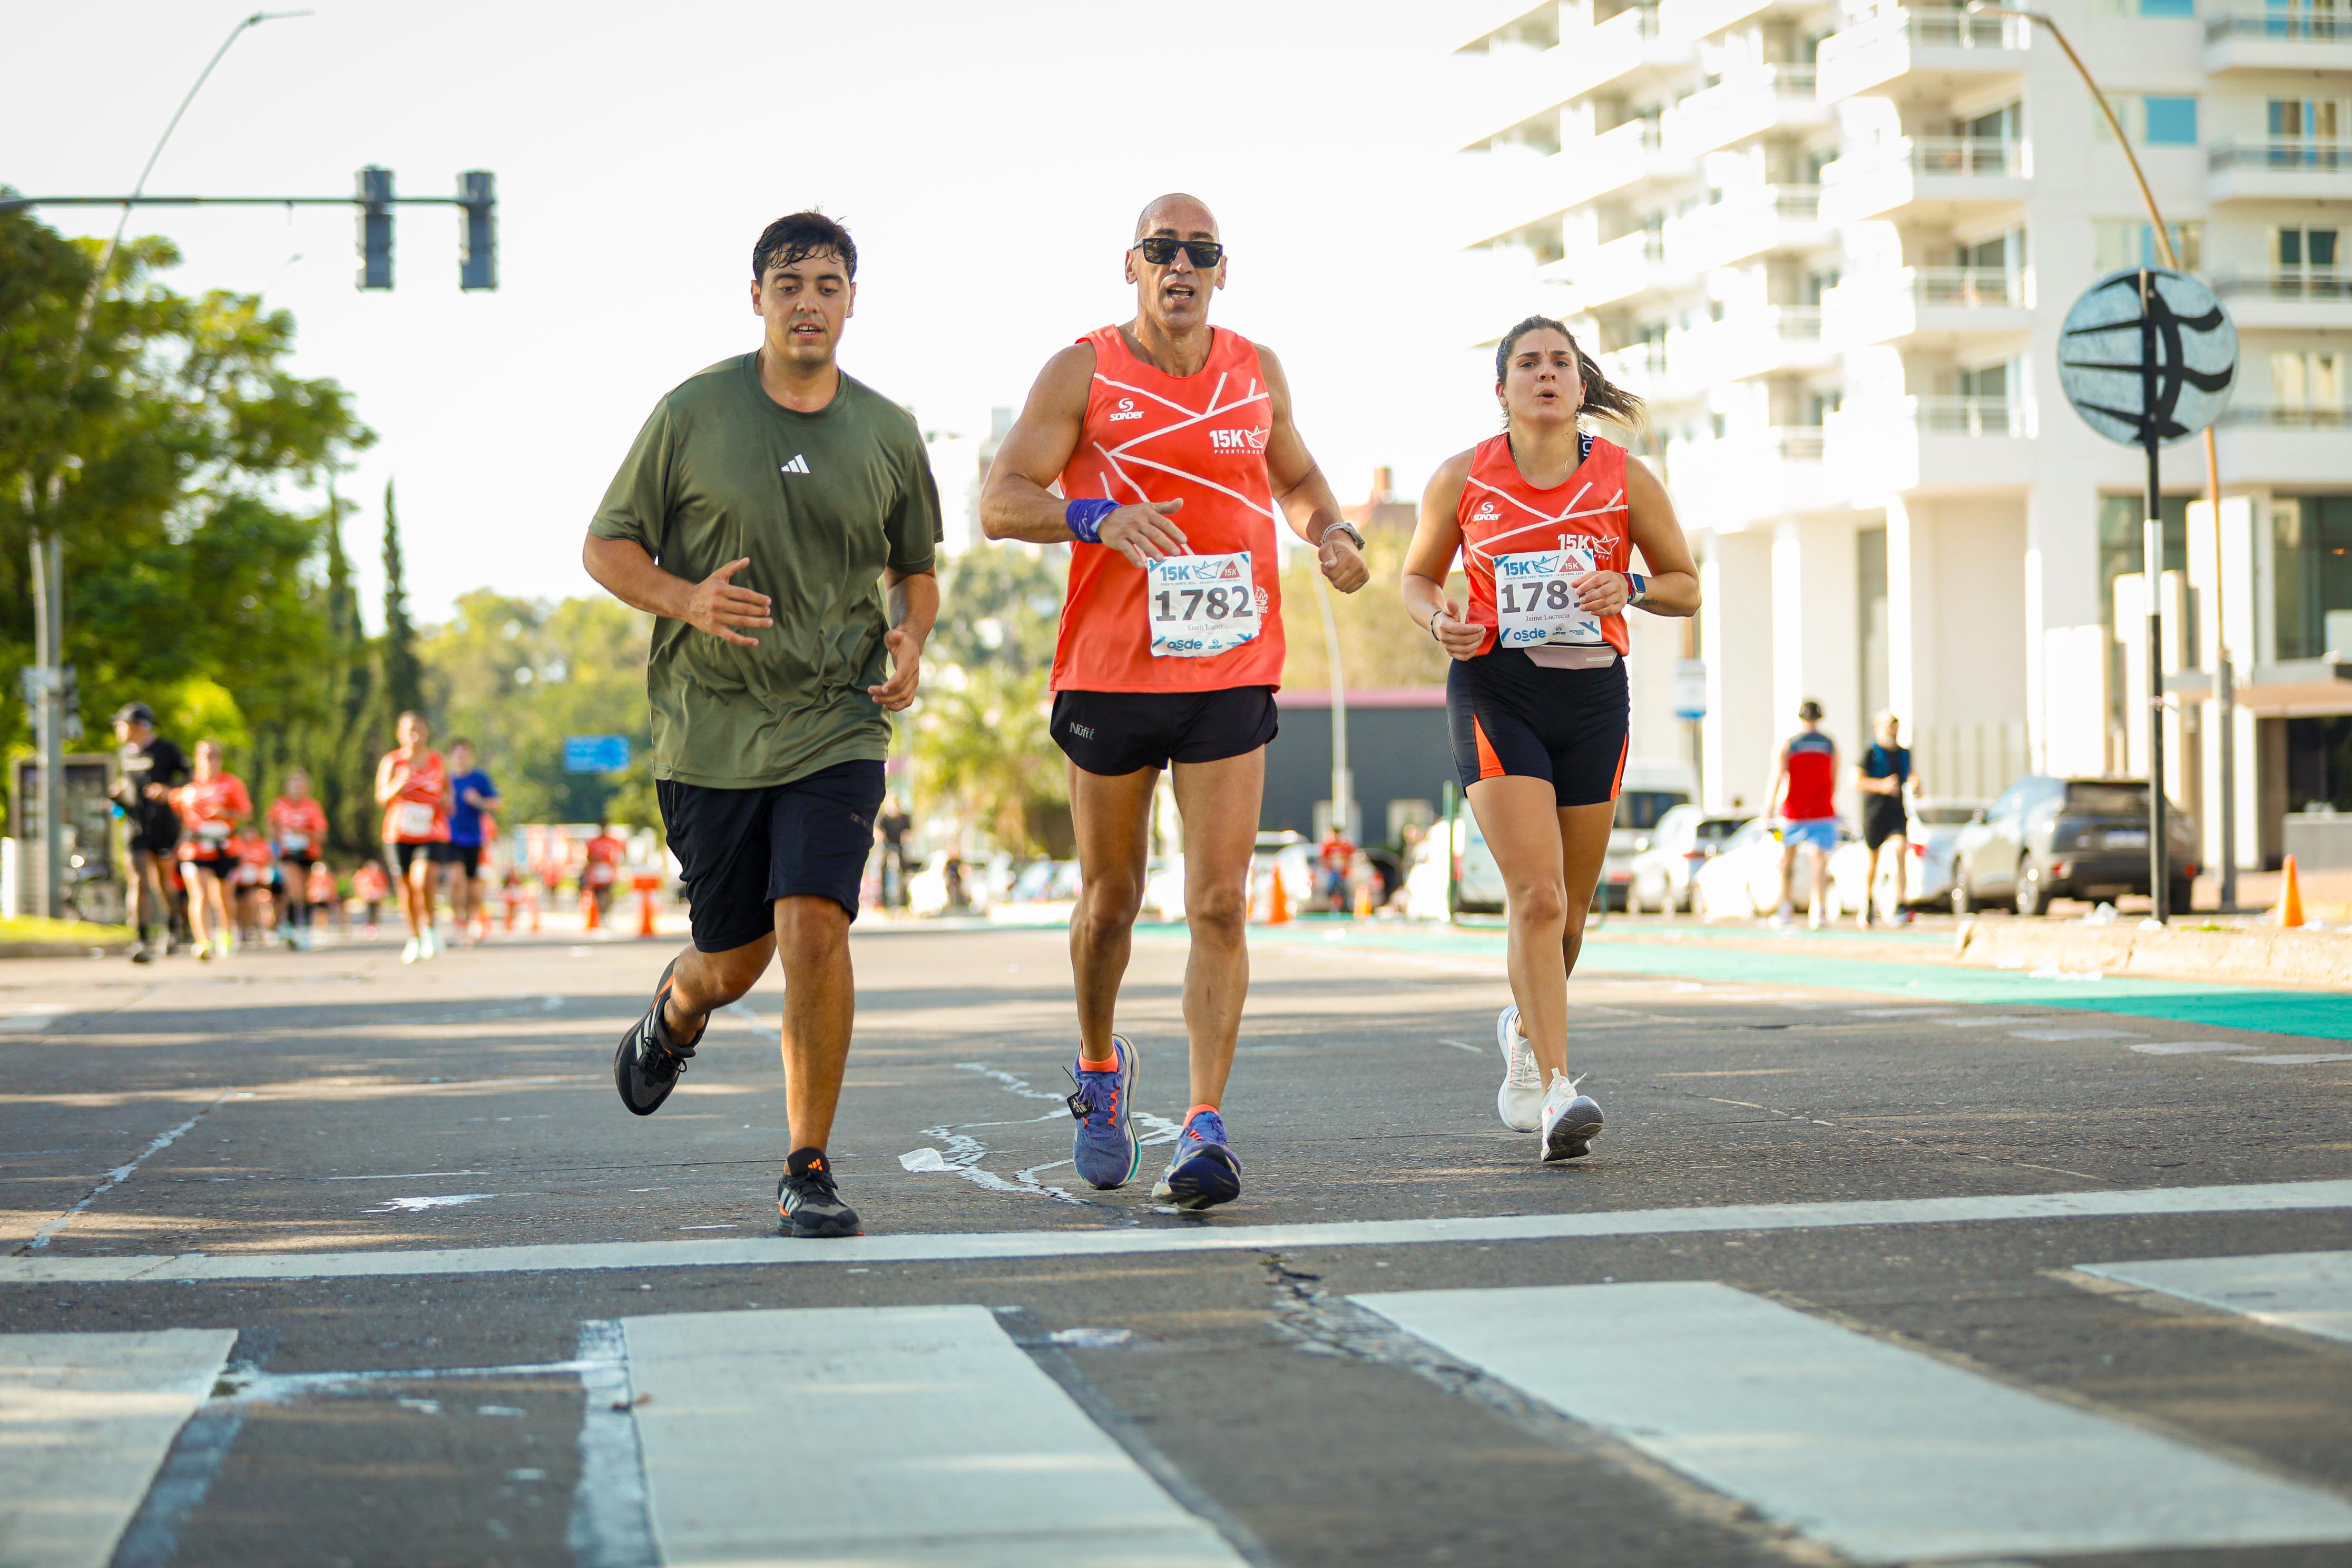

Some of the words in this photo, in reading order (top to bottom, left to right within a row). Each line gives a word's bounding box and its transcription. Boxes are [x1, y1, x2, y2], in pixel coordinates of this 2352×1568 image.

[1209, 429, 1244, 448] 15K
[1557, 534, 1591, 550] 15K
[1160, 565, 1191, 581] 15K
[1224, 568, 1238, 576] 15K
[1504, 561, 1530, 576] 15K
[1155, 585, 1253, 621] 1782
[1513, 628, 1546, 642] osde
[1167, 638, 1202, 651] osde
